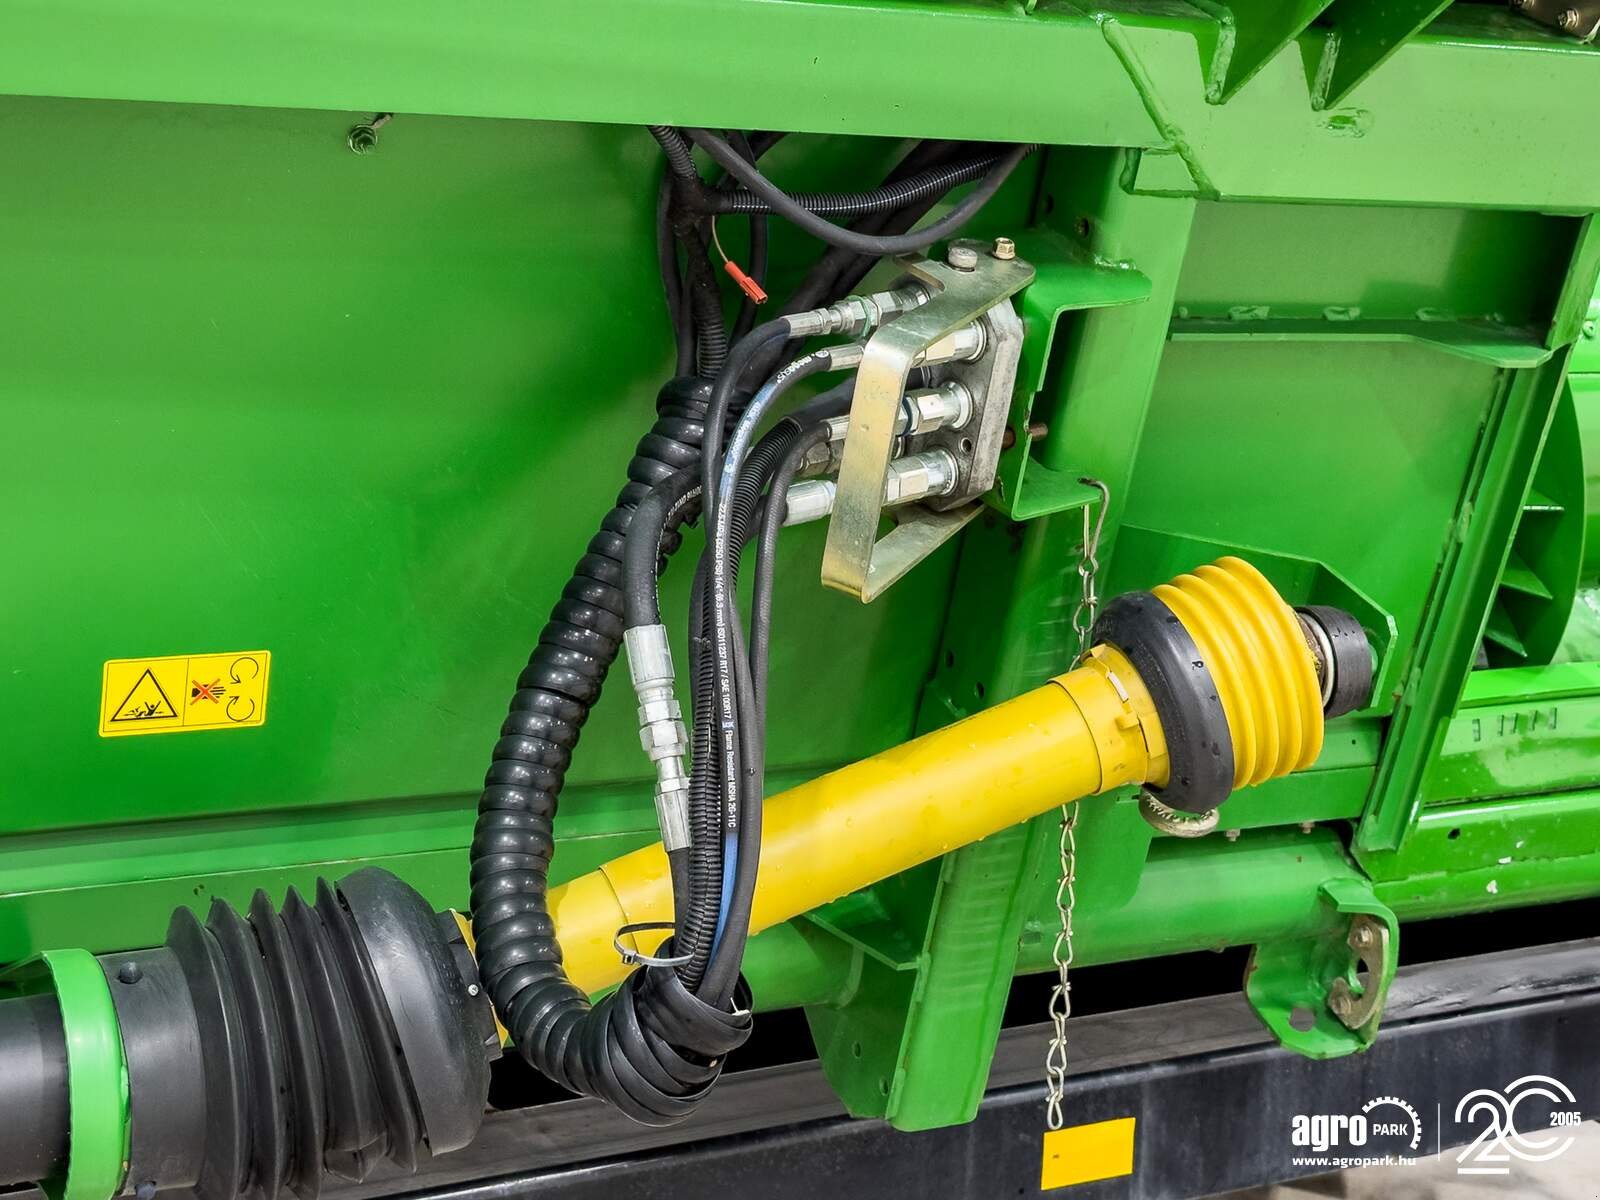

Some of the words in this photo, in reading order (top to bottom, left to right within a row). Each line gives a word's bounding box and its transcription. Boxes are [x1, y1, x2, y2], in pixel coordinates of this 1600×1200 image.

[716, 609, 725, 627] mm)
[717, 628, 727, 658] ISO11237
[719, 660, 728, 673] R17
[721, 679, 730, 693] SAE
[722, 694, 732, 719] 100R17
[725, 730, 733, 750] Flame
[726, 751, 735, 781] Resistant
[728, 782, 736, 801] MSHA
[728, 802, 736, 827] 2G-11C
